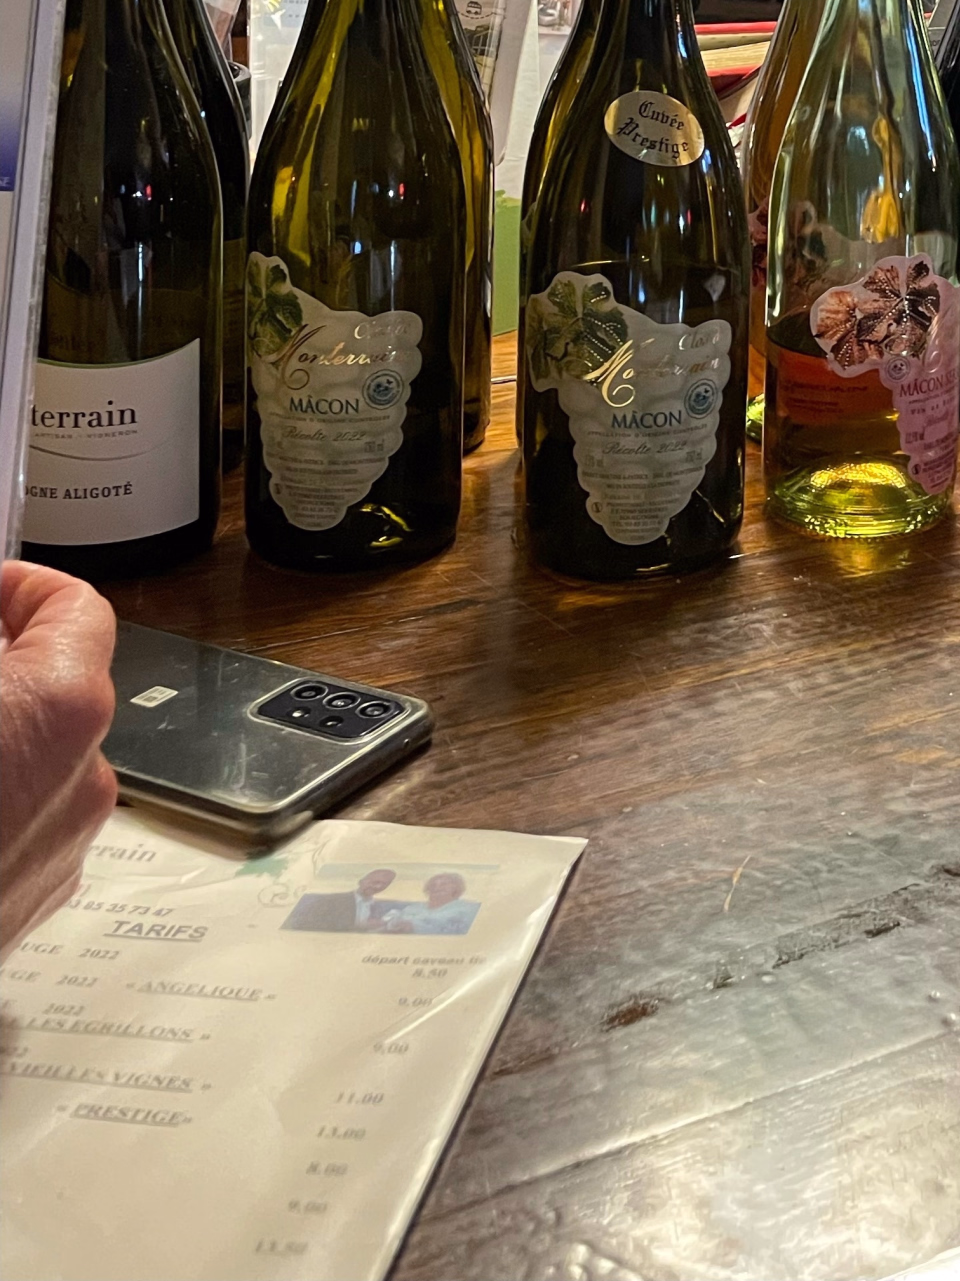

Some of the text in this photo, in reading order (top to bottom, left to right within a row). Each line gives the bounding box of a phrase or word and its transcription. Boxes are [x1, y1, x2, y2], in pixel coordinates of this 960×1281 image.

[638, 100, 685, 130] Cuvée
[616, 117, 689, 159] Prestige
[289, 394, 360, 416] MÂCON
[611, 409, 682, 430] MÂCON
[62, 480, 134, 501] ALIGOTÉ
[109, 919, 209, 940] TARIFS
[78, 947, 121, 960] 2022
[360, 955, 411, 966] départ
[138, 980, 263, 1002] ANGELIQUE
